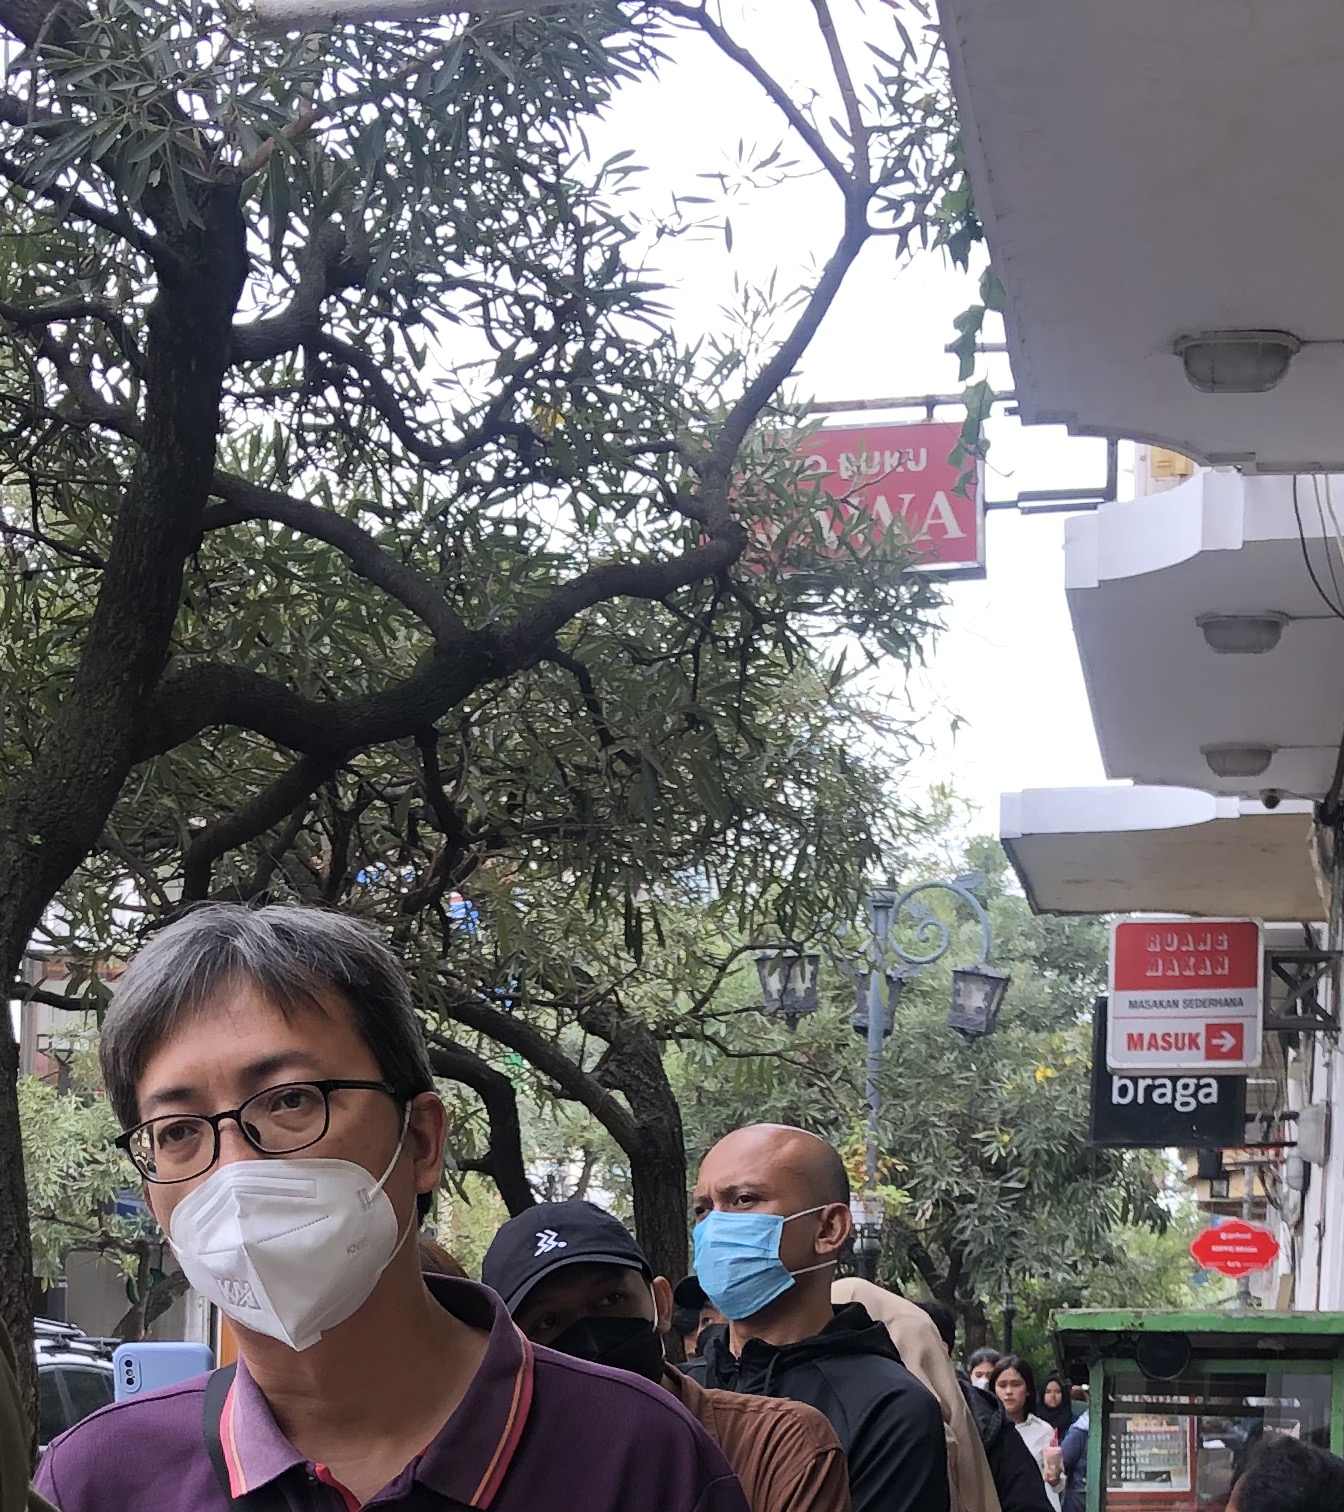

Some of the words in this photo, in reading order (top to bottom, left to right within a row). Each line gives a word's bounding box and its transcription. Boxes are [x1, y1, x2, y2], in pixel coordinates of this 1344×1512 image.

[1128, 999, 1180, 1010] MASAKAN
[1182, 997, 1245, 1010] SEDERHANA
[1126, 1032, 1202, 1052] MASUK
[1111, 1075, 1219, 1113] braga
